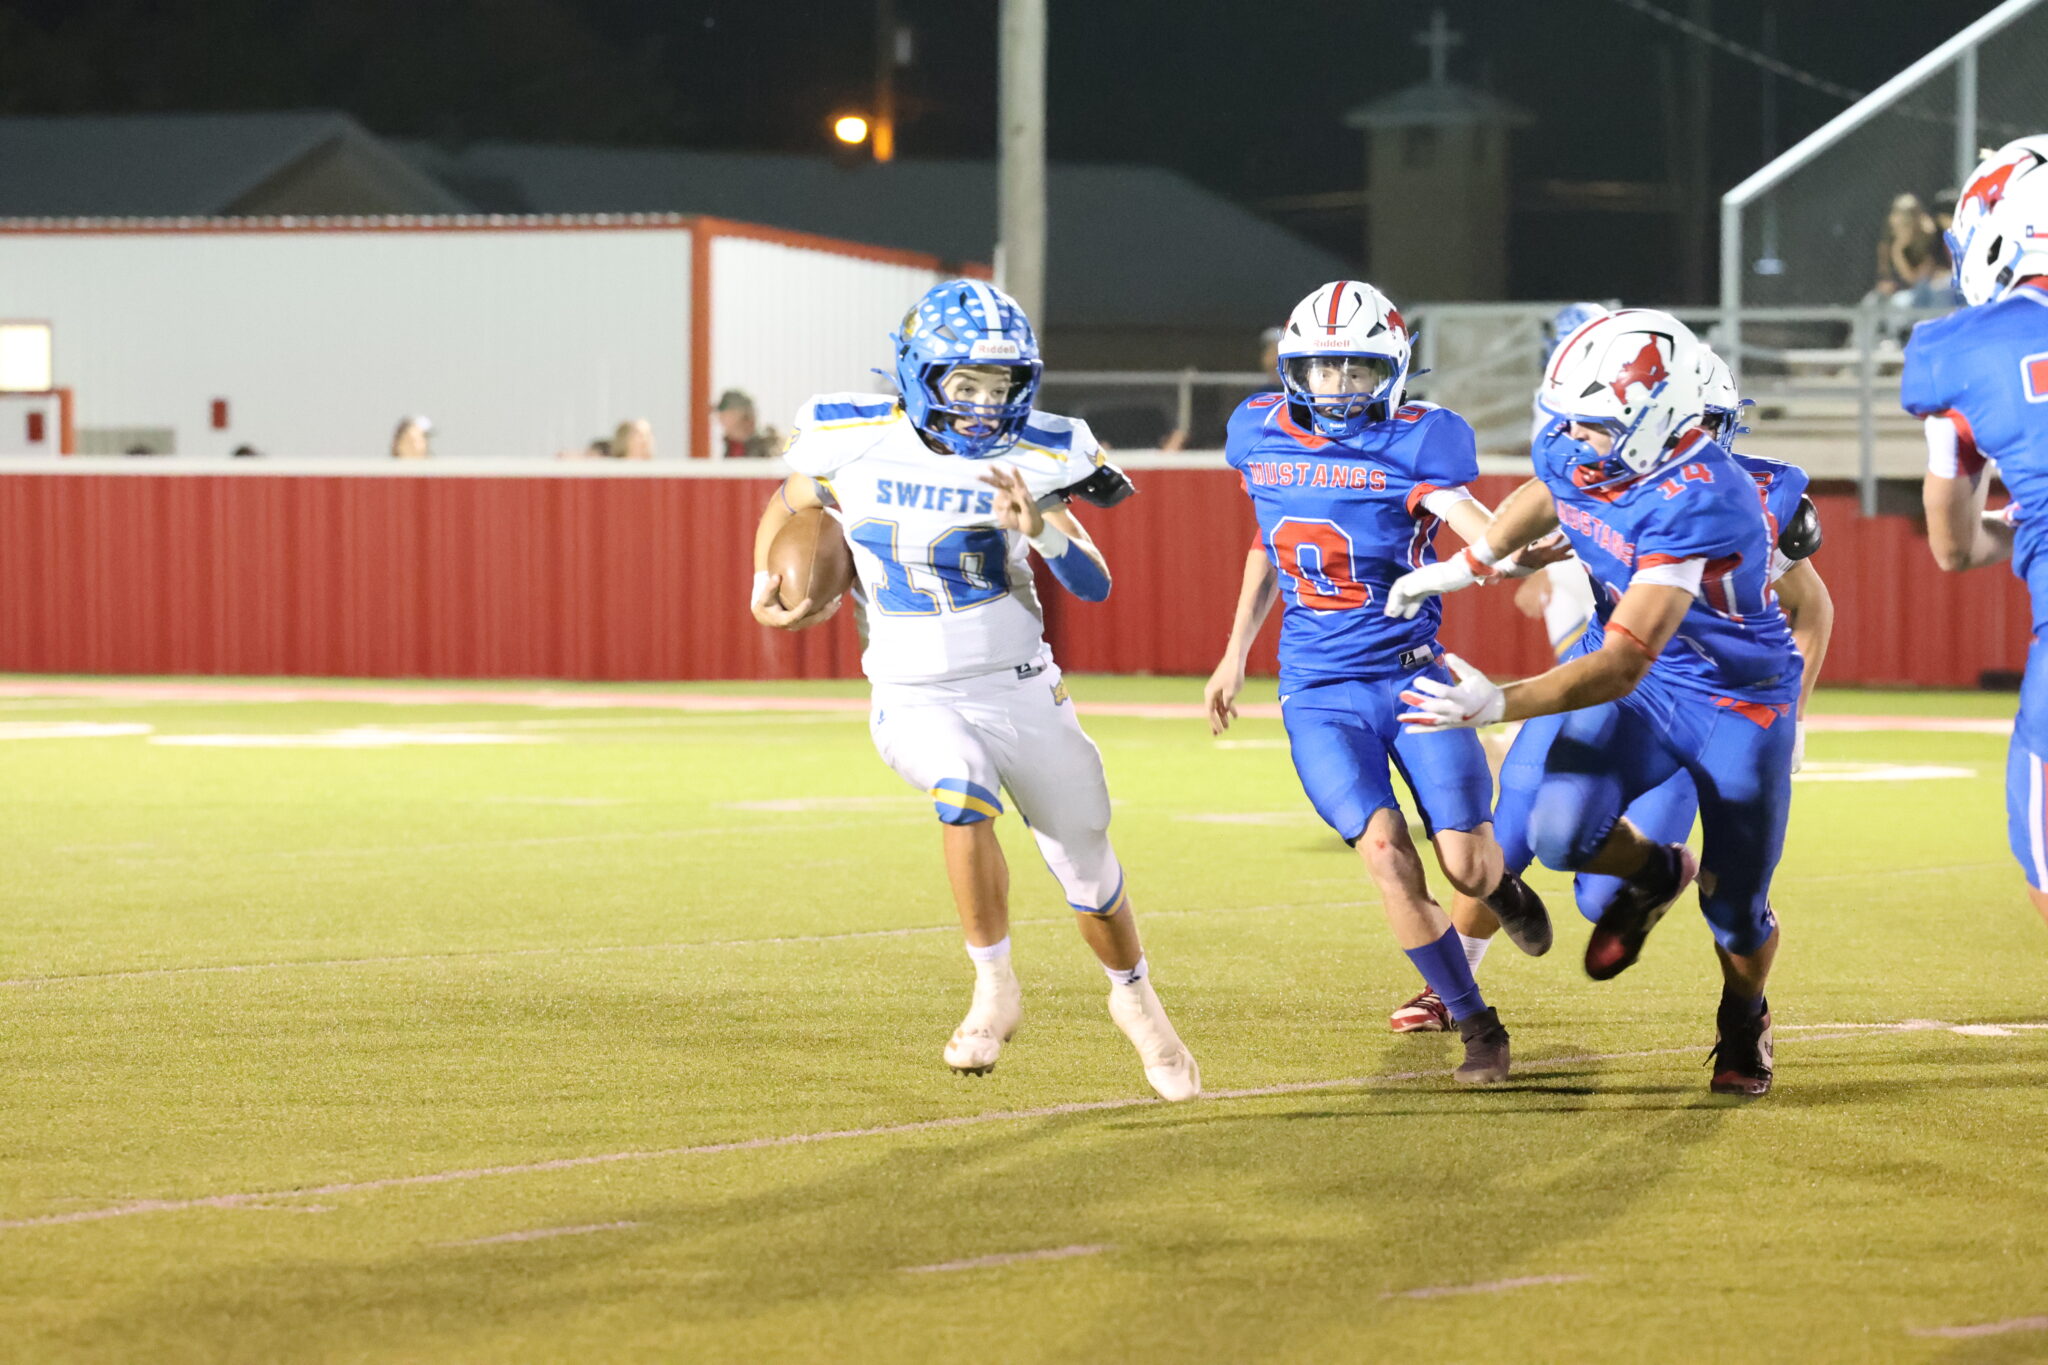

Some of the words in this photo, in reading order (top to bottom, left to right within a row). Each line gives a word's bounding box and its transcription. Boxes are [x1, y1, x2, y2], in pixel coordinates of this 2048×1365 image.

[978, 345, 1016, 353] Riddell
[1313, 340, 1350, 348] Riddell
[1248, 462, 1387, 492] MUSTANGS
[1655, 462, 1715, 500] 14
[876, 479, 994, 515] SWIFTS
[850, 517, 1012, 617] 10
[1269, 515, 1375, 616] 0
